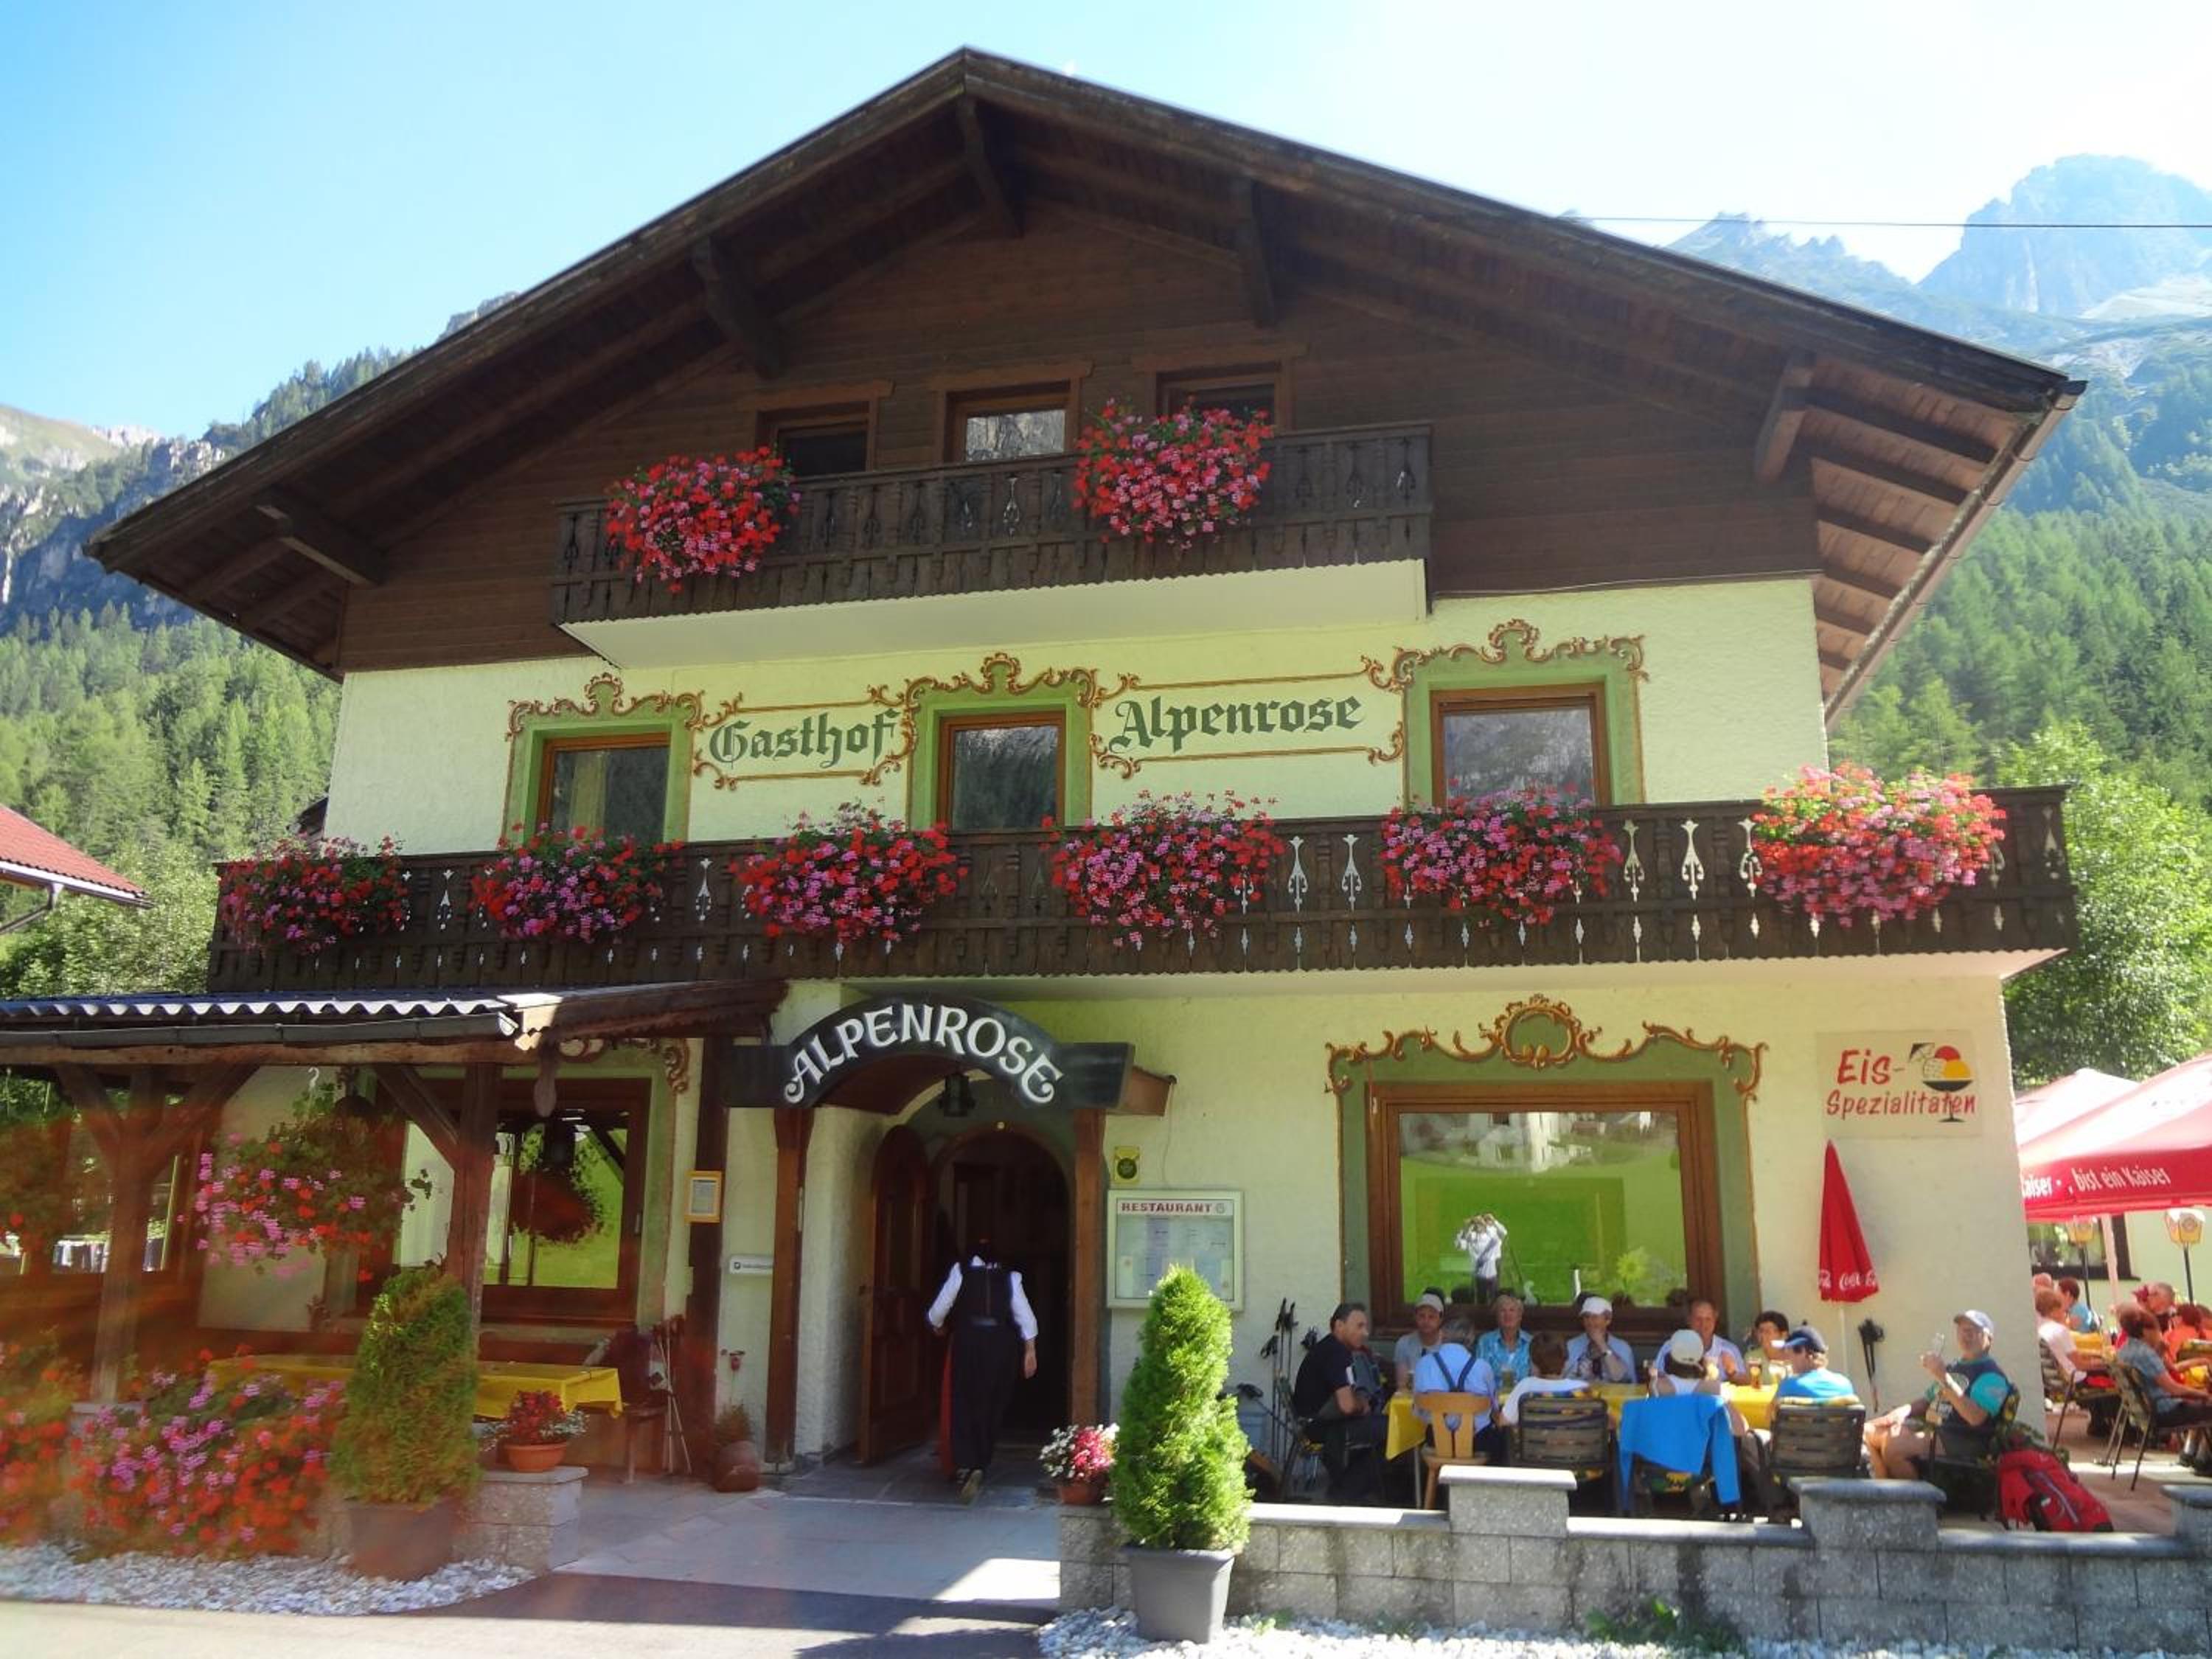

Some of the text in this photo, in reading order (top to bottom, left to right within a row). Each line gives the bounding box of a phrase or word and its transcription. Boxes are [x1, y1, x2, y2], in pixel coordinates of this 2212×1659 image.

[709, 695, 1365, 769] Gasthof Alpenrose
[784, 1003, 1064, 1104] ALPENROSE
[1121, 1202, 1213, 1214] RESTAURANT
